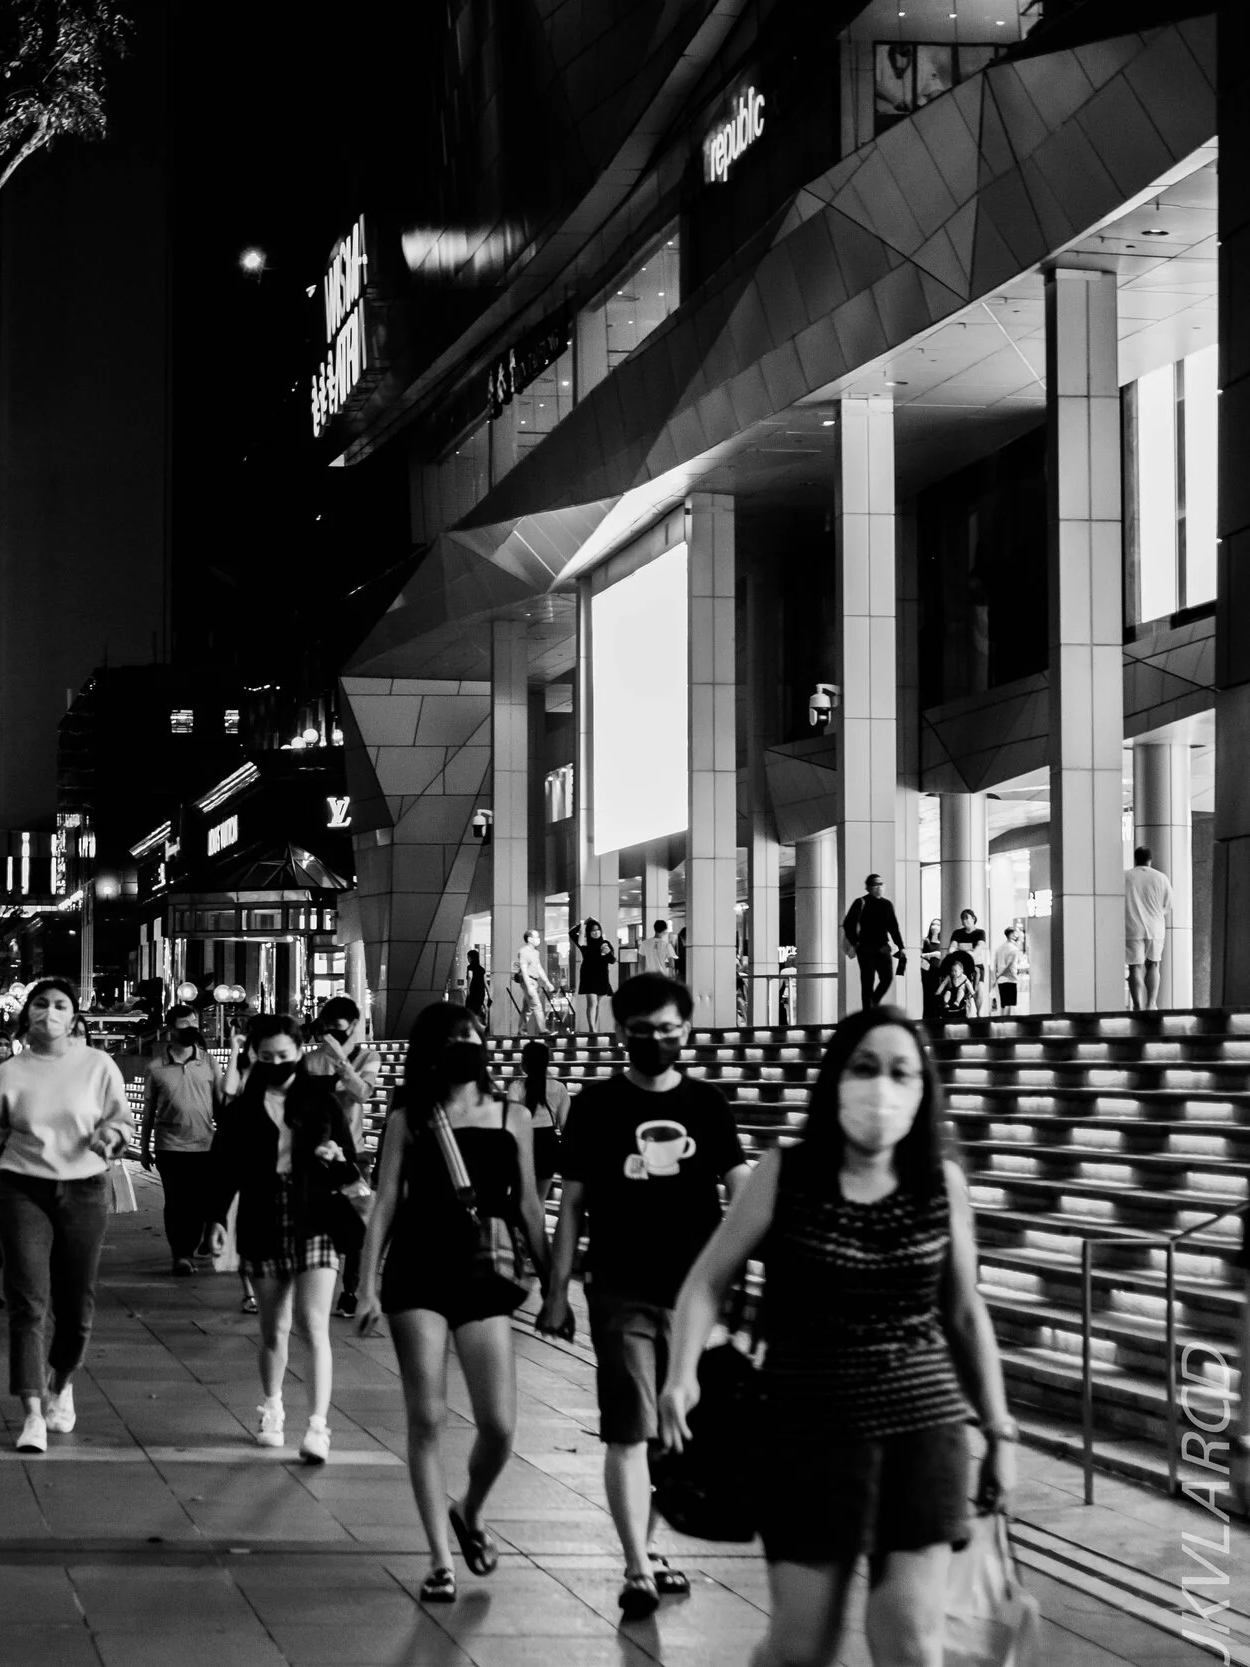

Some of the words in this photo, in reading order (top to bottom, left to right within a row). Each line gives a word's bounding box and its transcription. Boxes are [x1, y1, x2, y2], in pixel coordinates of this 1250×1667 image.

[711, 86, 765, 182] republic
[324, 213, 368, 344] WISMA
[334, 297, 367, 413] ATRIA
[326, 796, 352, 828] LV
